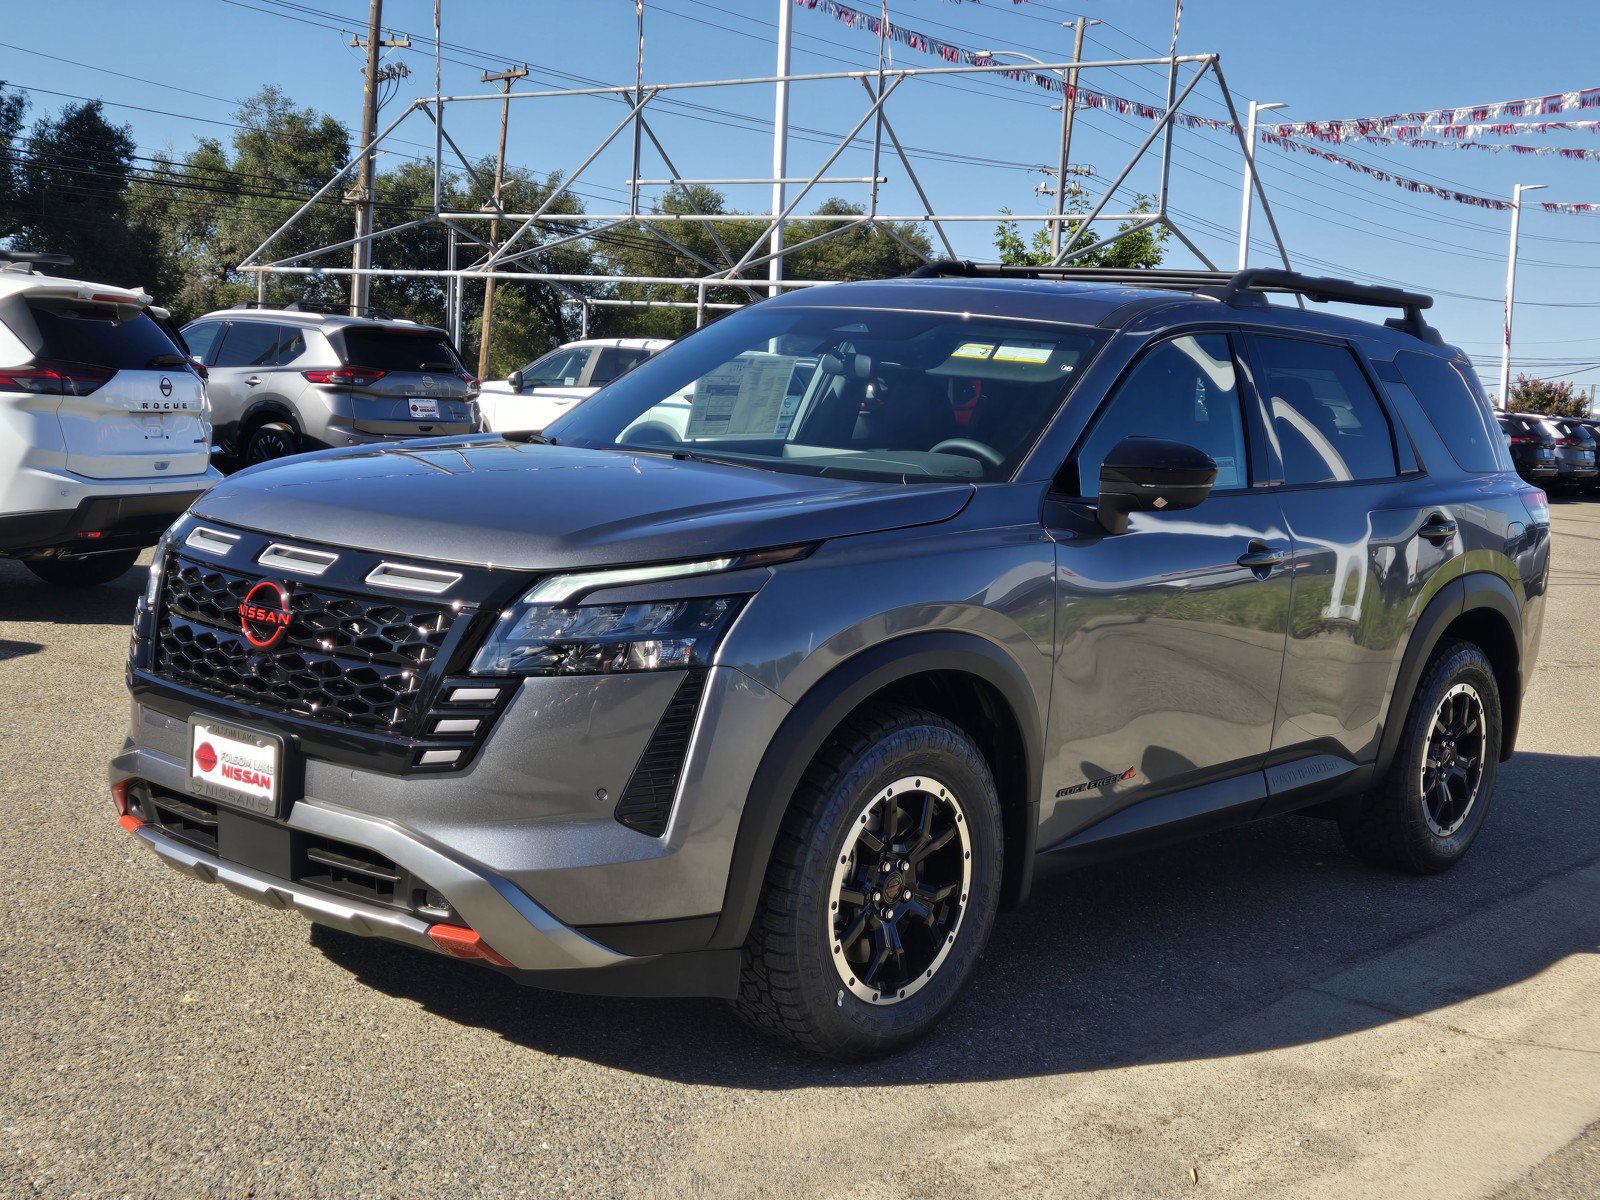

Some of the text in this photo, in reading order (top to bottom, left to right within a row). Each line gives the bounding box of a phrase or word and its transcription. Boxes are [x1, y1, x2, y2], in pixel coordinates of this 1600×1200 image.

[142, 402, 188, 410] ROGUE
[238, 603, 291, 625] NISSAN
[220, 751, 252, 769] FOLSOM
[221, 763, 271, 790] NISSAN
[205, 784, 255, 808] NISSAN
